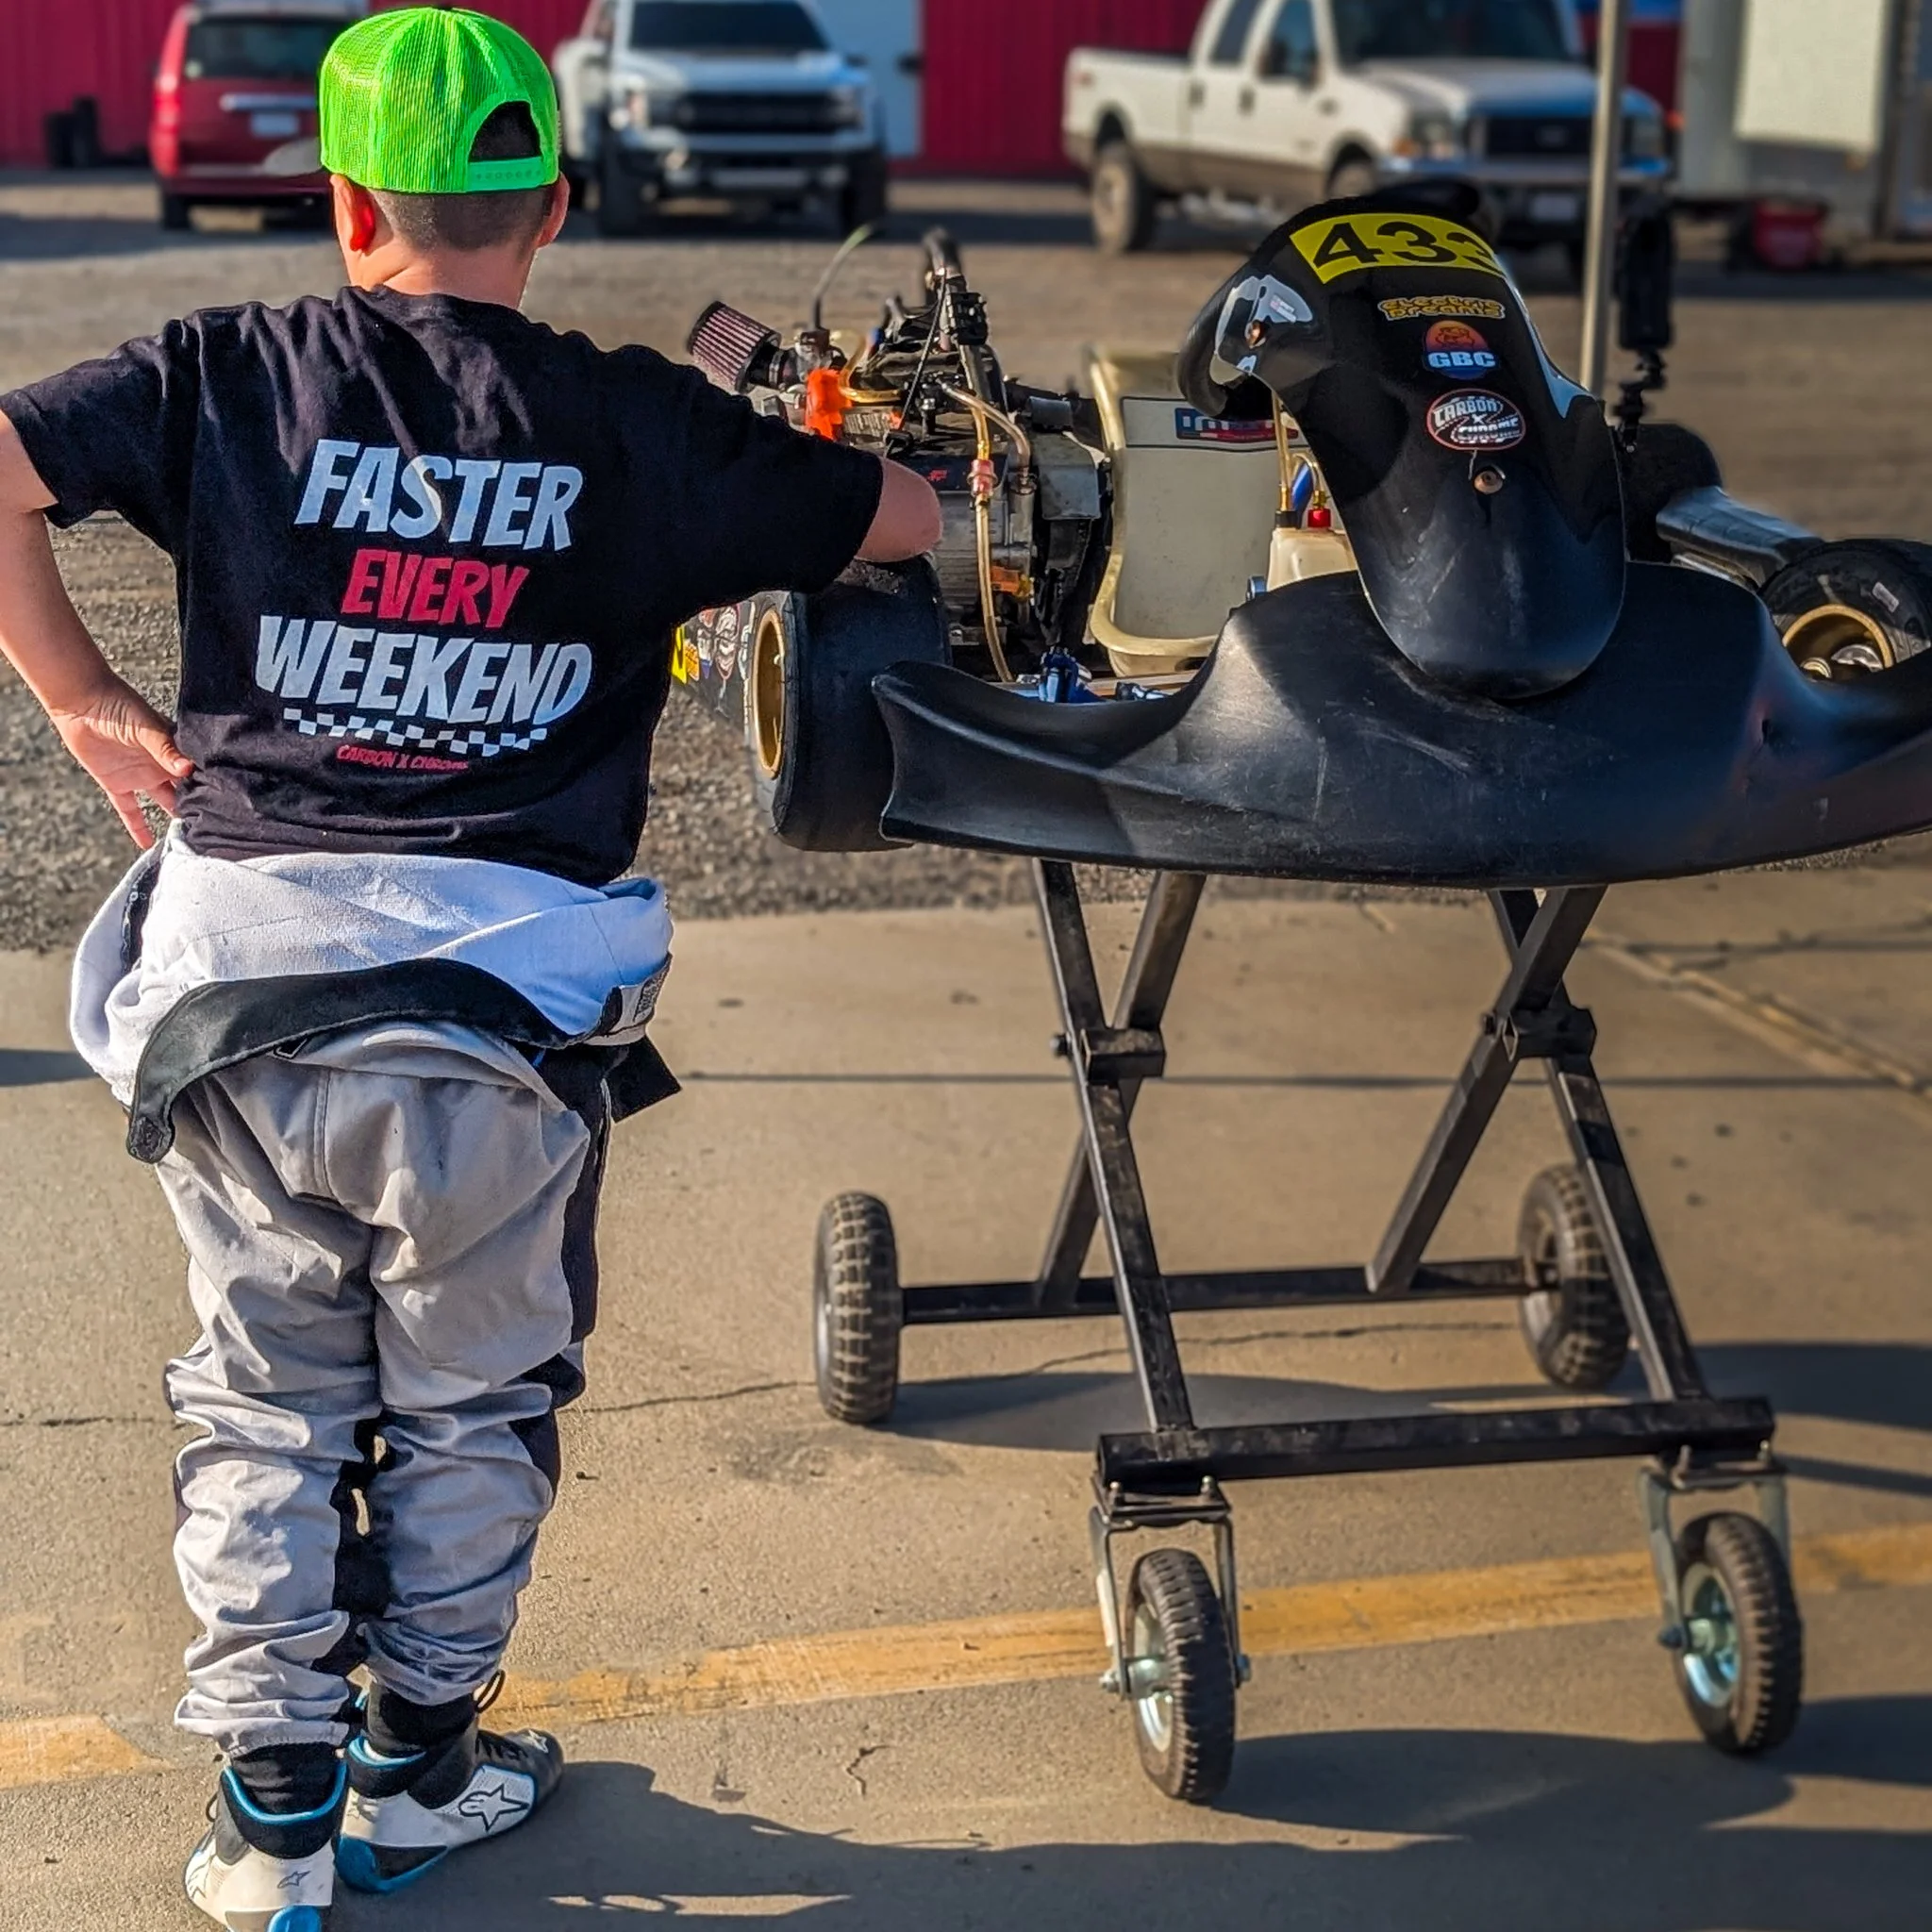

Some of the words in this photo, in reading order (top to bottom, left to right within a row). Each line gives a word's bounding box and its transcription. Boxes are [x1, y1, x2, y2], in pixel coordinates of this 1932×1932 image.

[1313, 221, 1508, 275] 433
[1428, 352, 1496, 368] GBC
[1434, 398, 1497, 427] CARBON
[294, 439, 582, 551] FASTER
[341, 548, 529, 627] EVERY
[255, 615, 591, 725] WEEKEND
[337, 744, 394, 768] CARBON
[395, 753, 409, 769] X
